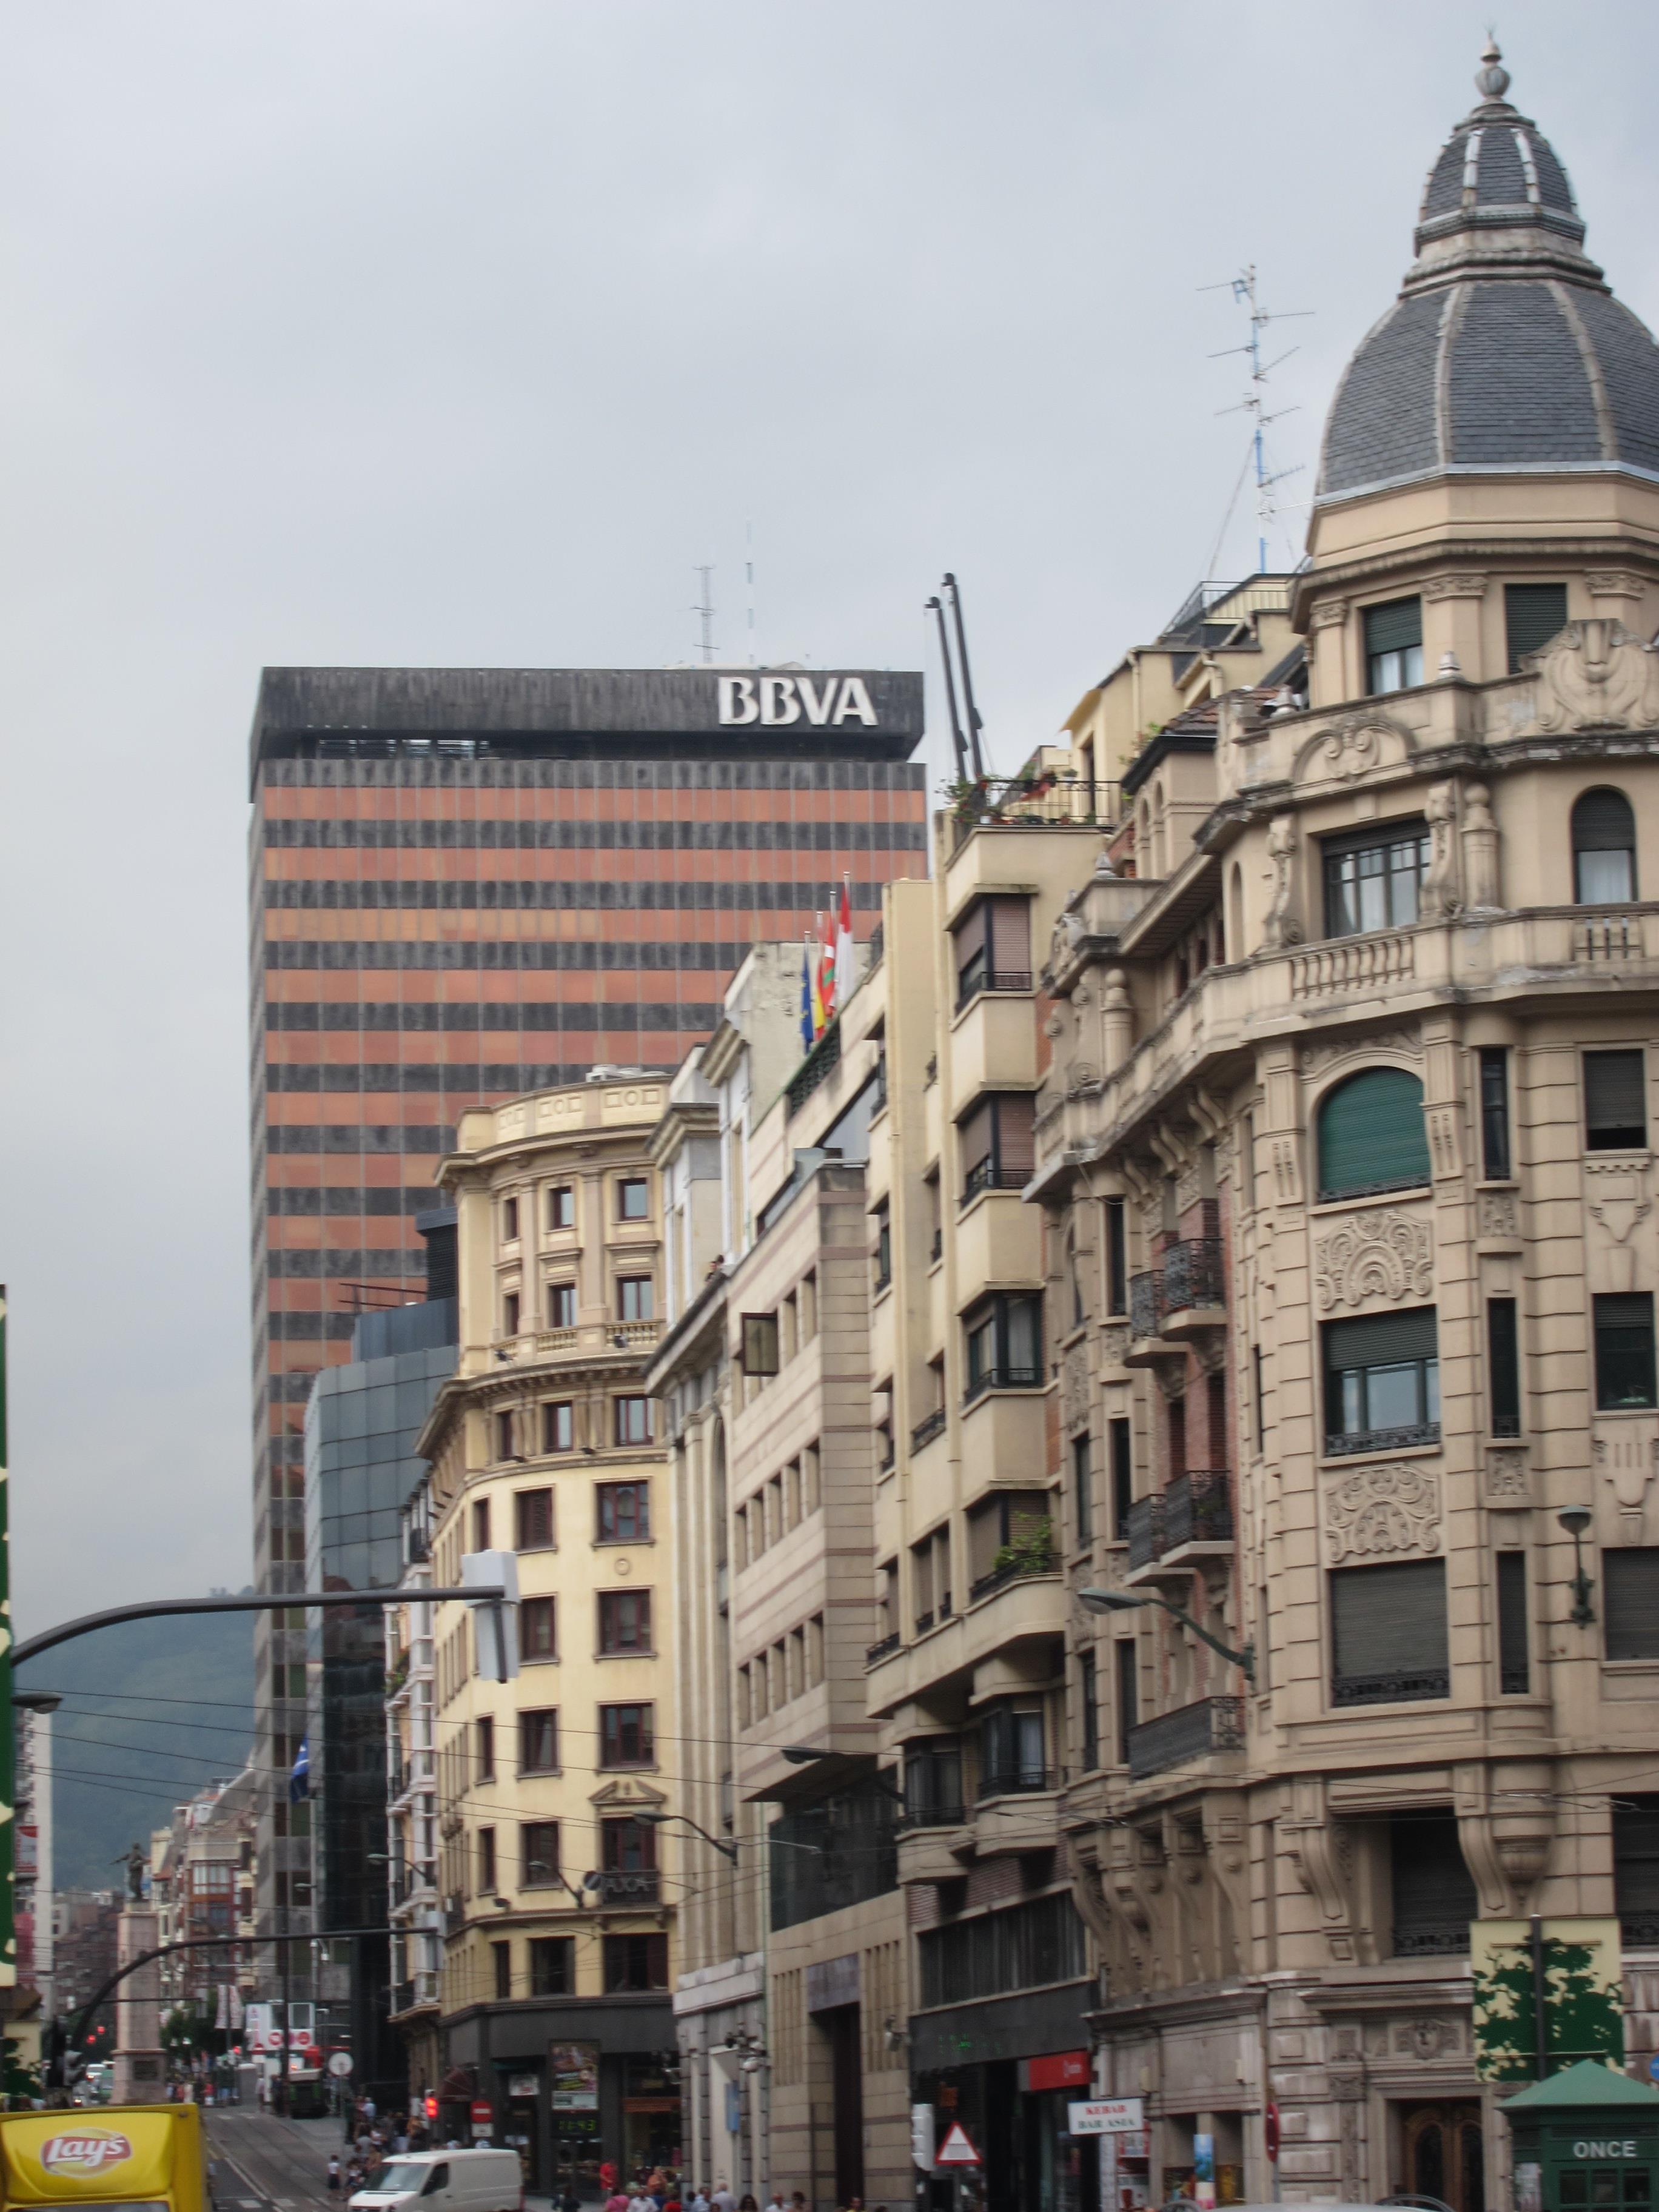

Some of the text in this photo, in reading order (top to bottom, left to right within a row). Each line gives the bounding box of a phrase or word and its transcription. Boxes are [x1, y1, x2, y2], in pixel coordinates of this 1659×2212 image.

[719, 677, 879, 726] BBVA
[1085, 2105, 1126, 2115] KEBAB
[1078, 2120, 1102, 2129] BAR
[1574, 2141, 1637, 2157] ONCE
